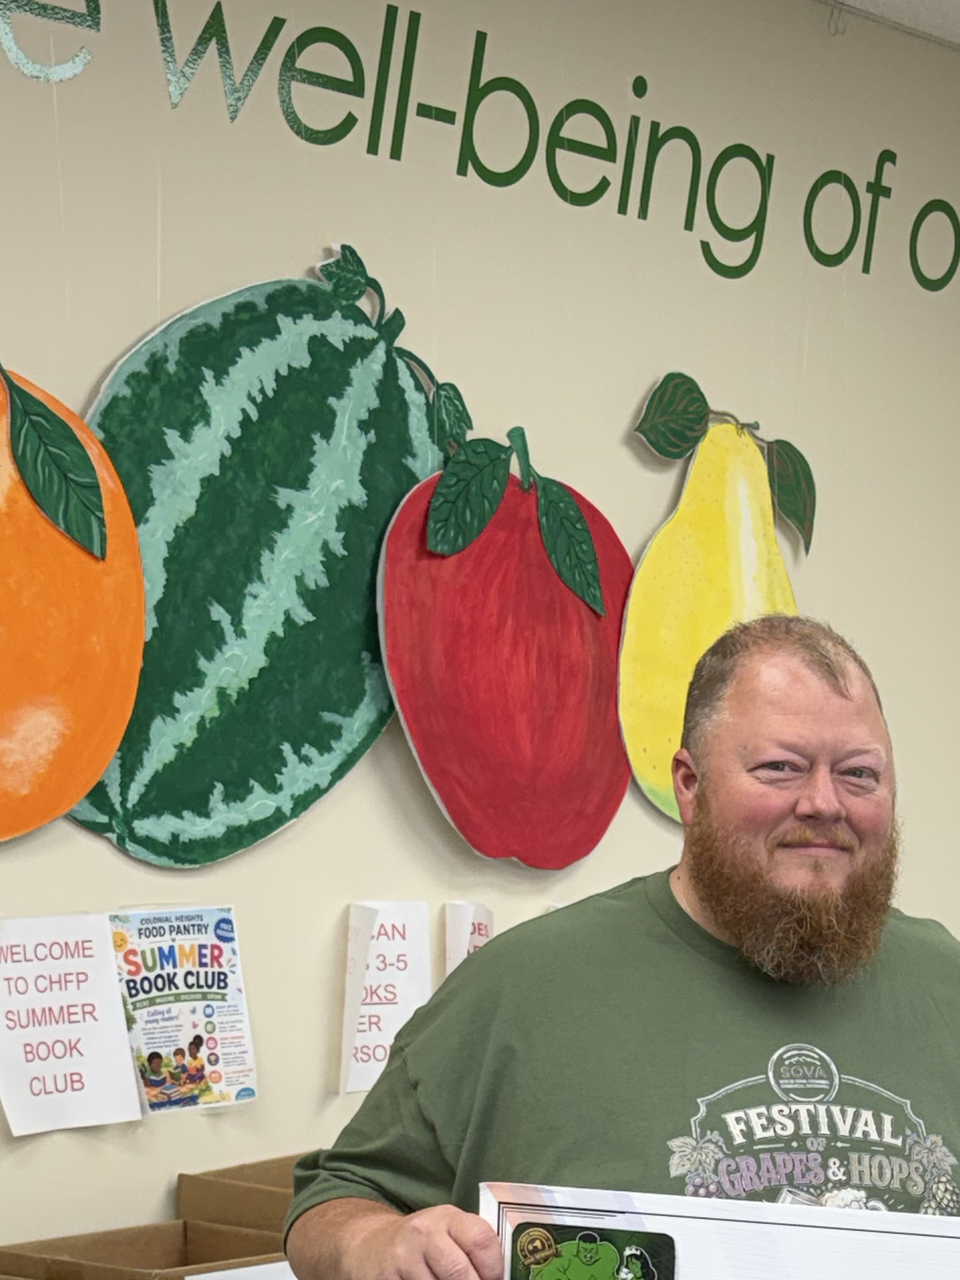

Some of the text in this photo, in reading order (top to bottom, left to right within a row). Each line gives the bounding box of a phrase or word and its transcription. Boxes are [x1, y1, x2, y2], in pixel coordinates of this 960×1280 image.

[150, 0, 776, 280] well-being
[803, 149, 898, 275] of
[137, 924, 166, 940] FOOD
[169, 923, 209, 937] PANTRY
[140, 916, 173, 926] COLONIAL
[123, 943, 224, 977] SUMMER
[376, 953, 408, 972] 3-5
[3, 971, 89, 996] TO CHFP
[125, 970, 229, 999] BOOK CLUB
[5, 1003, 99, 1031] SUMMER
[23, 1038, 84, 1063] BOOK
[29, 1072, 85, 1097] CLUB
[780, 1065, 827, 1079] SOVA
[721, 1101, 903, 1146] FESTIVAL
[806, 1137, 826, 1151] OF
[717, 1151, 925, 1197] GRAPES & HOPS
